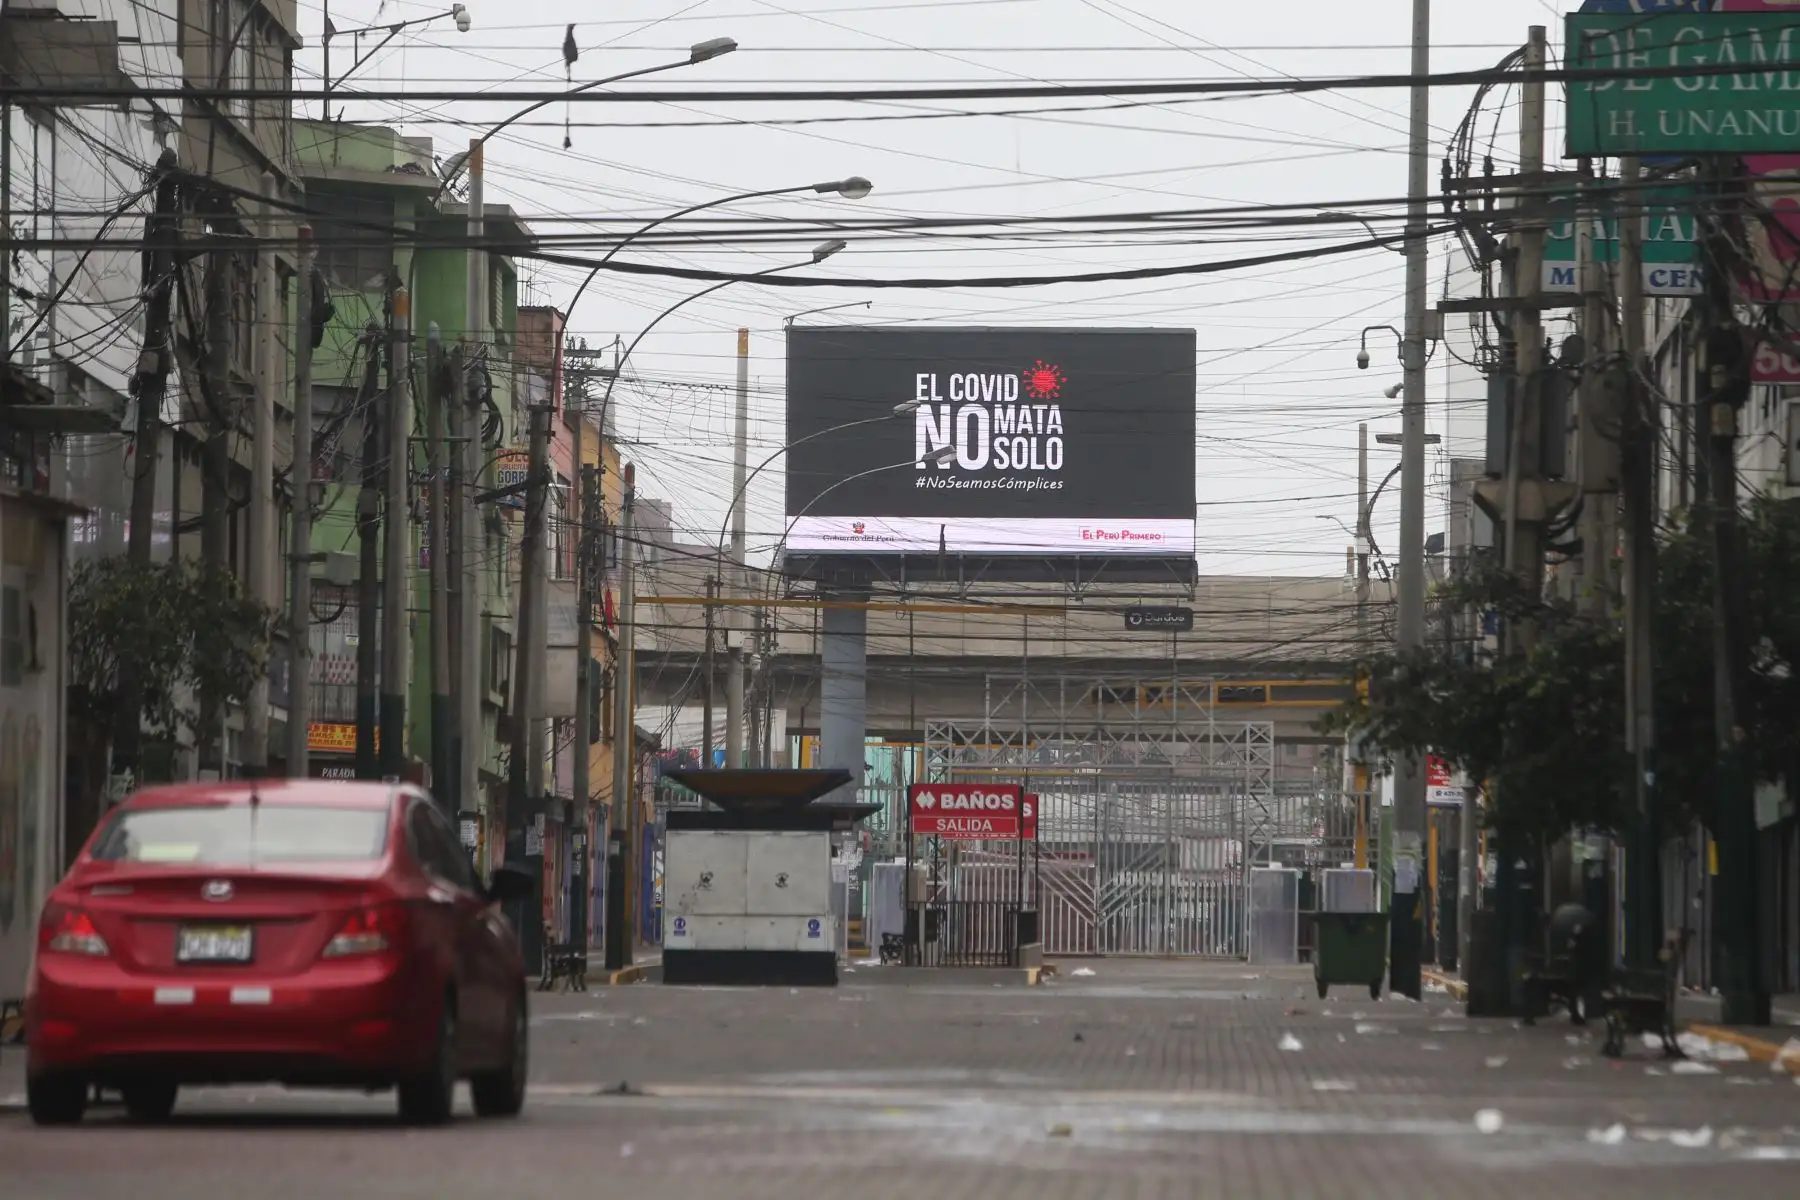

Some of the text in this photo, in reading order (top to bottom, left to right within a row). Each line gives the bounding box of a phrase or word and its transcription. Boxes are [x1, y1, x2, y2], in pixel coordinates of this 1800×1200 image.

[916, 373, 1019, 401] EL COVID
[994, 404, 1063, 434] MATA
[915, 403, 990, 470] NO
[993, 437, 1063, 470] SOLO
[915, 475, 1064, 492] #NoSeamosCómplices
[940, 791, 1015, 810] BAÑOS
[936, 818, 993, 832] SALIDA
